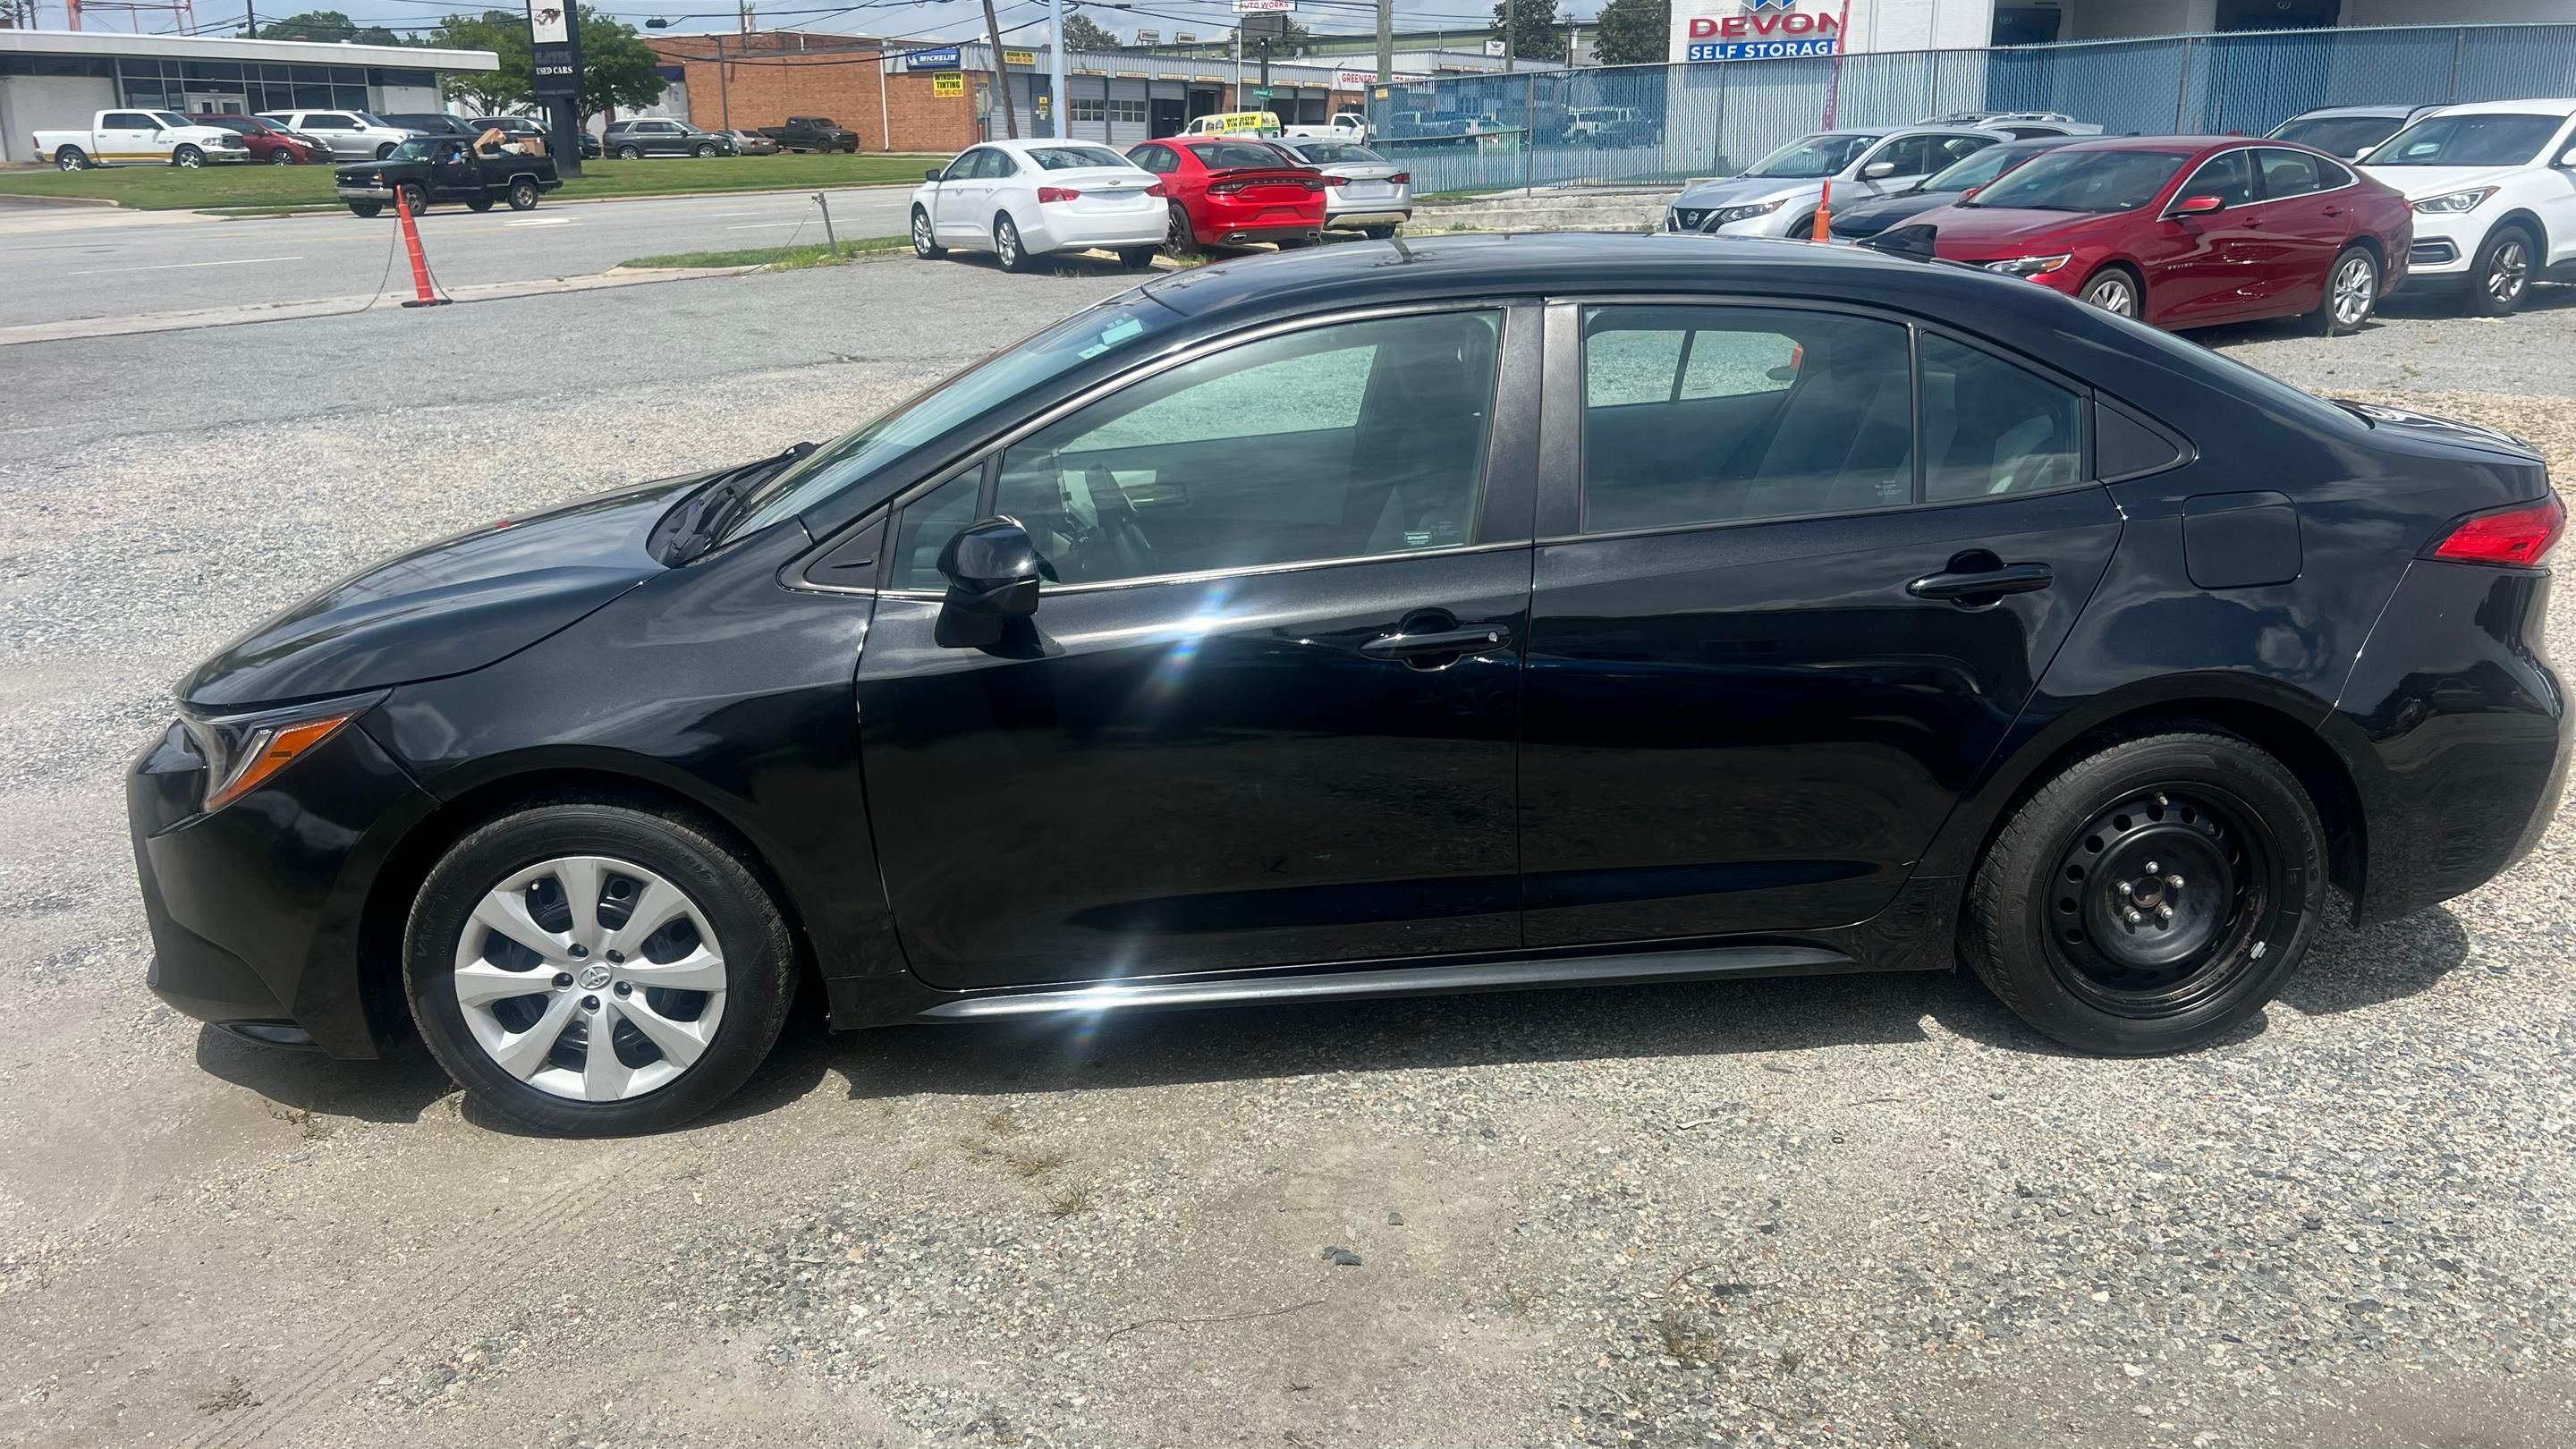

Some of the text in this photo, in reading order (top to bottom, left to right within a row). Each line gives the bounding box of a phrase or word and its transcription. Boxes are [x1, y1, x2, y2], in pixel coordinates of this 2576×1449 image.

[1261, 0, 1289, 9] WORKS
[1689, 13, 1839, 38] DEVON
[1690, 45, 1737, 60] SELF
[919, 54, 957, 62] MICHELIN
[537, 66, 573, 75] USED CARS
[1342, 73, 1378, 82] GREENSBO
